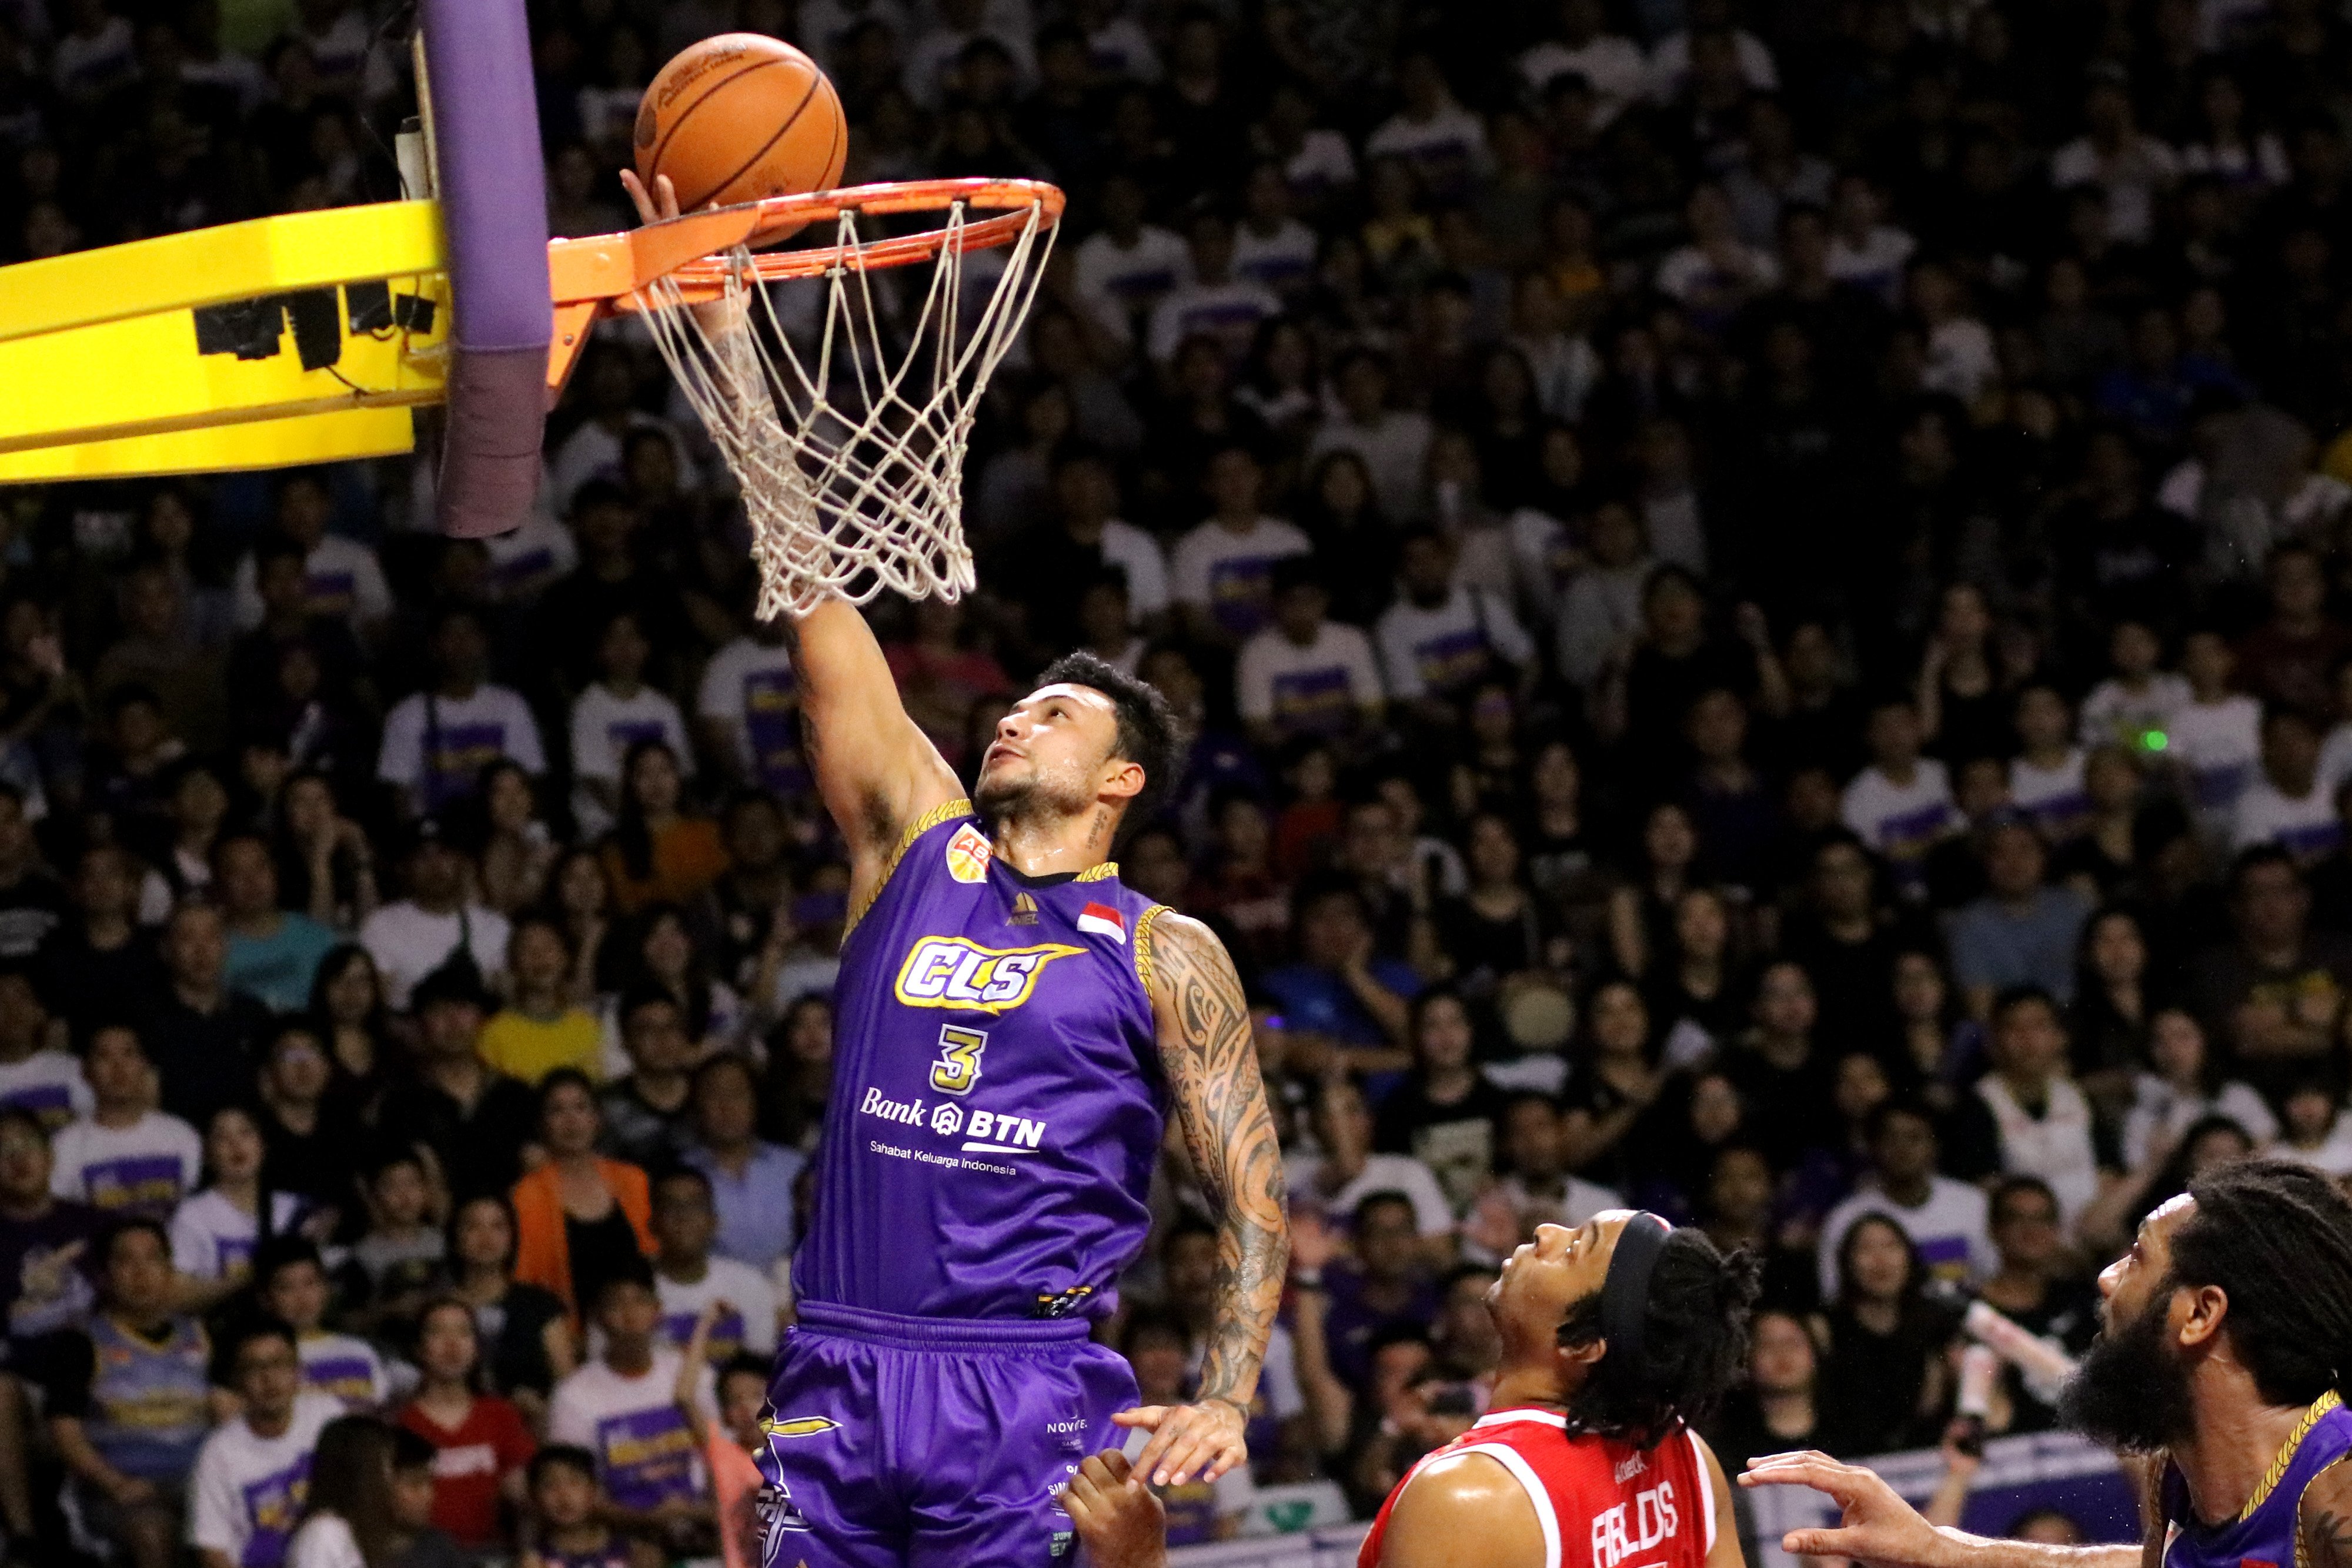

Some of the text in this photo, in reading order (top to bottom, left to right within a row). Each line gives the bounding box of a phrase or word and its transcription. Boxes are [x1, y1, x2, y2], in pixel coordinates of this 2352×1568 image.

[960, 838, 990, 864] AB
[900, 939, 1053, 1004] CLS
[929, 1024, 988, 1095] 3
[860, 1087, 1047, 1148] Bank BTN
[870, 1141, 1016, 1175] Sahabat Keluarga Indonesia
